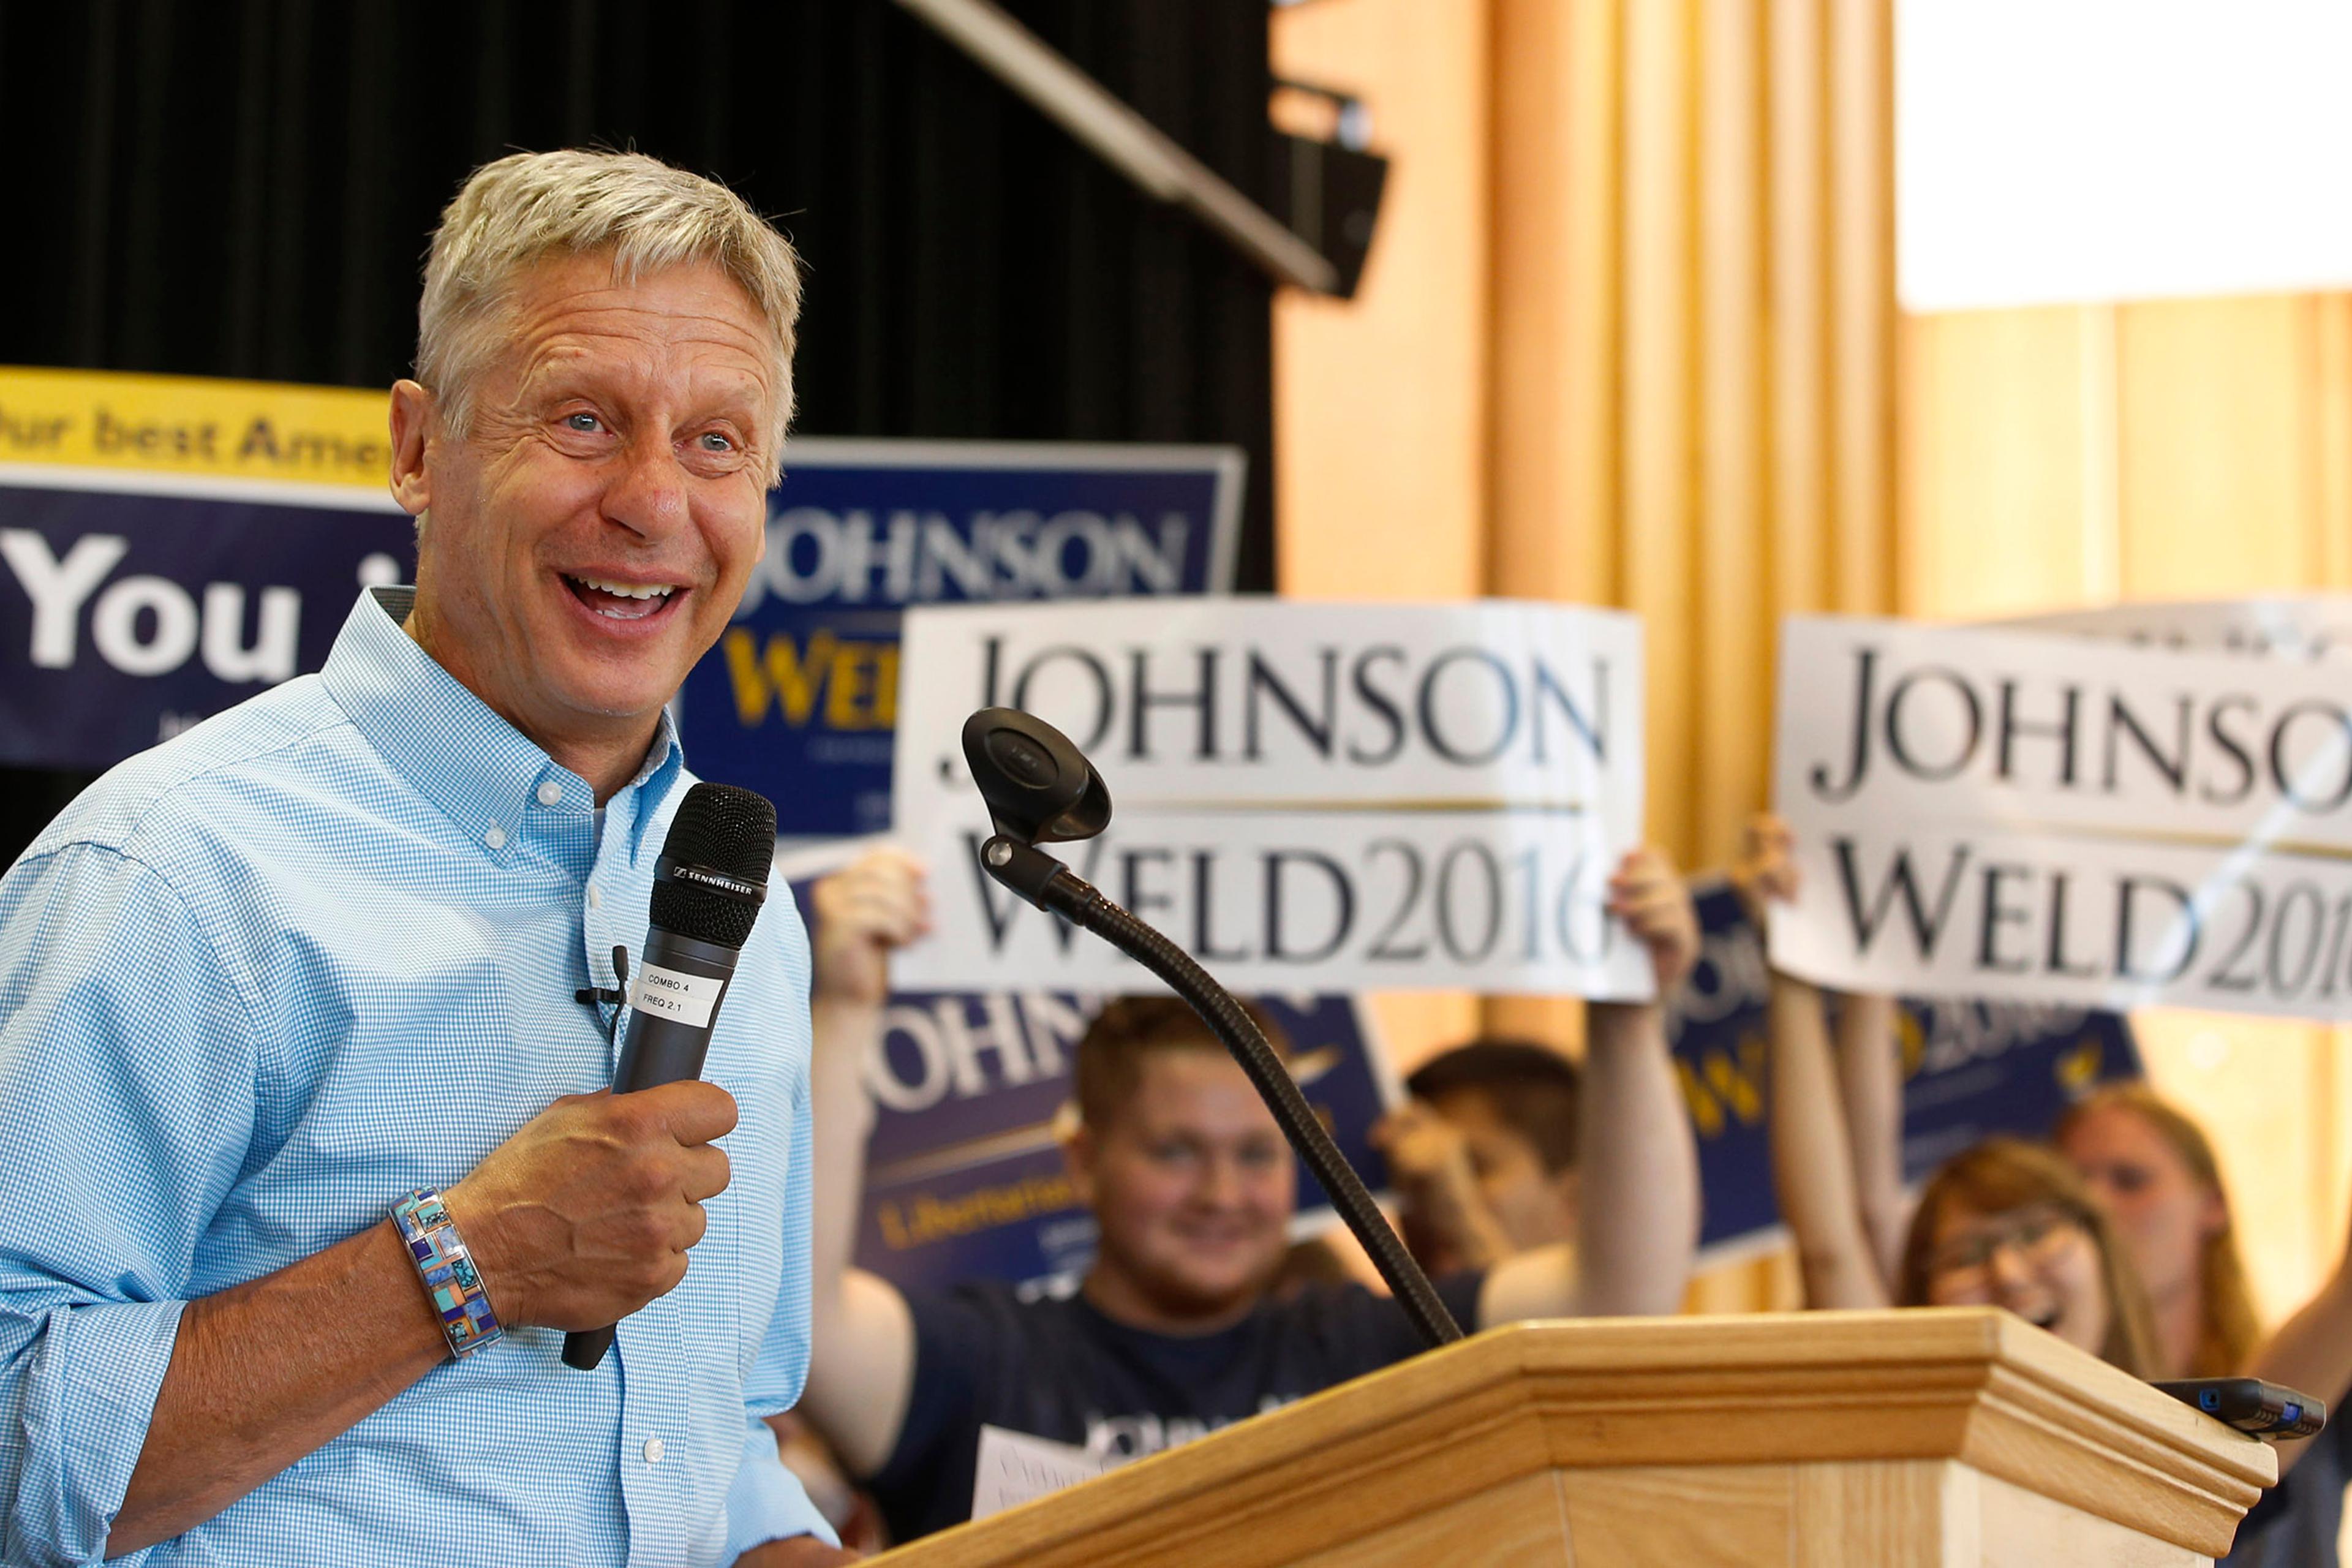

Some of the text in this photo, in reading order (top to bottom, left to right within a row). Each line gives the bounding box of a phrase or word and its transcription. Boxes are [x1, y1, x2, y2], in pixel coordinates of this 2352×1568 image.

[0, 401, 391, 472] ur best Ame
[0, 528, 301, 684] You
[935, 635, 1611, 788] JOHNSON
[688, 872, 752, 895] SENNHEISER
[643, 993, 665, 1008] FREQ
[649, 974, 680, 990] COMBO
